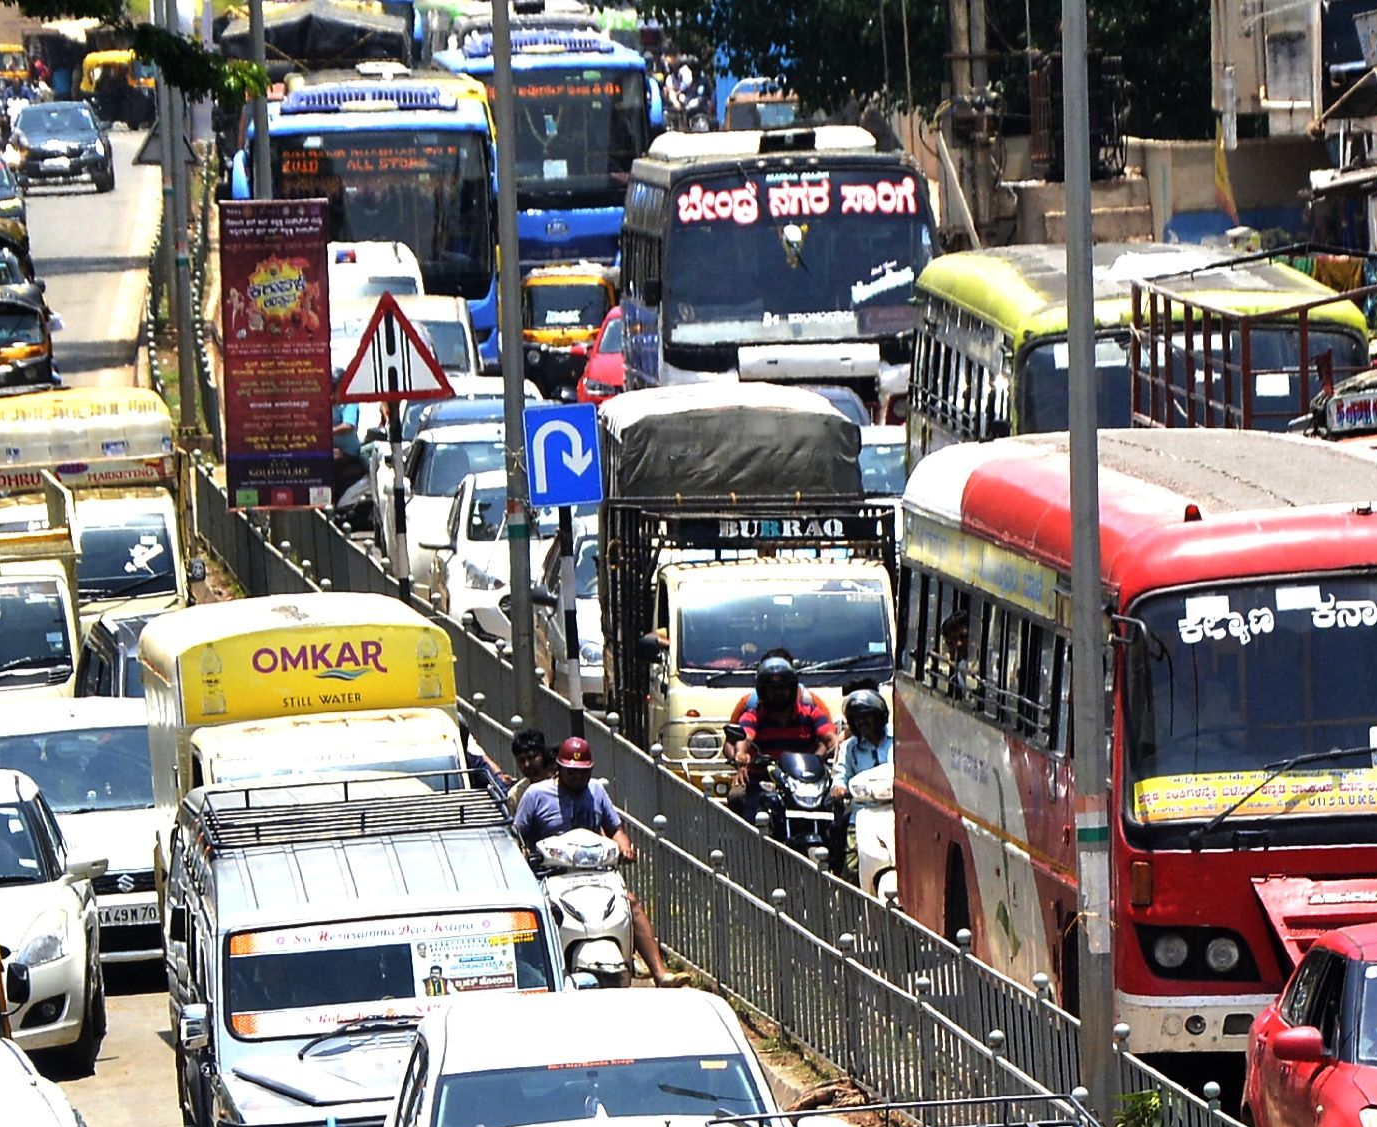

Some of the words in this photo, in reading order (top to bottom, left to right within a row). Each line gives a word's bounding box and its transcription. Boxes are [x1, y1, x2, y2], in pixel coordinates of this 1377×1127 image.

[768, 178, 831, 217] ನಗರ
[841, 175, 918, 214] ಸಾರಿಗೆ
[718, 519, 845, 539] BURRAQ
[252, 641, 387, 674] OMKAR
[282, 696, 312, 708] STILL
[319, 693, 361, 705] WATER
